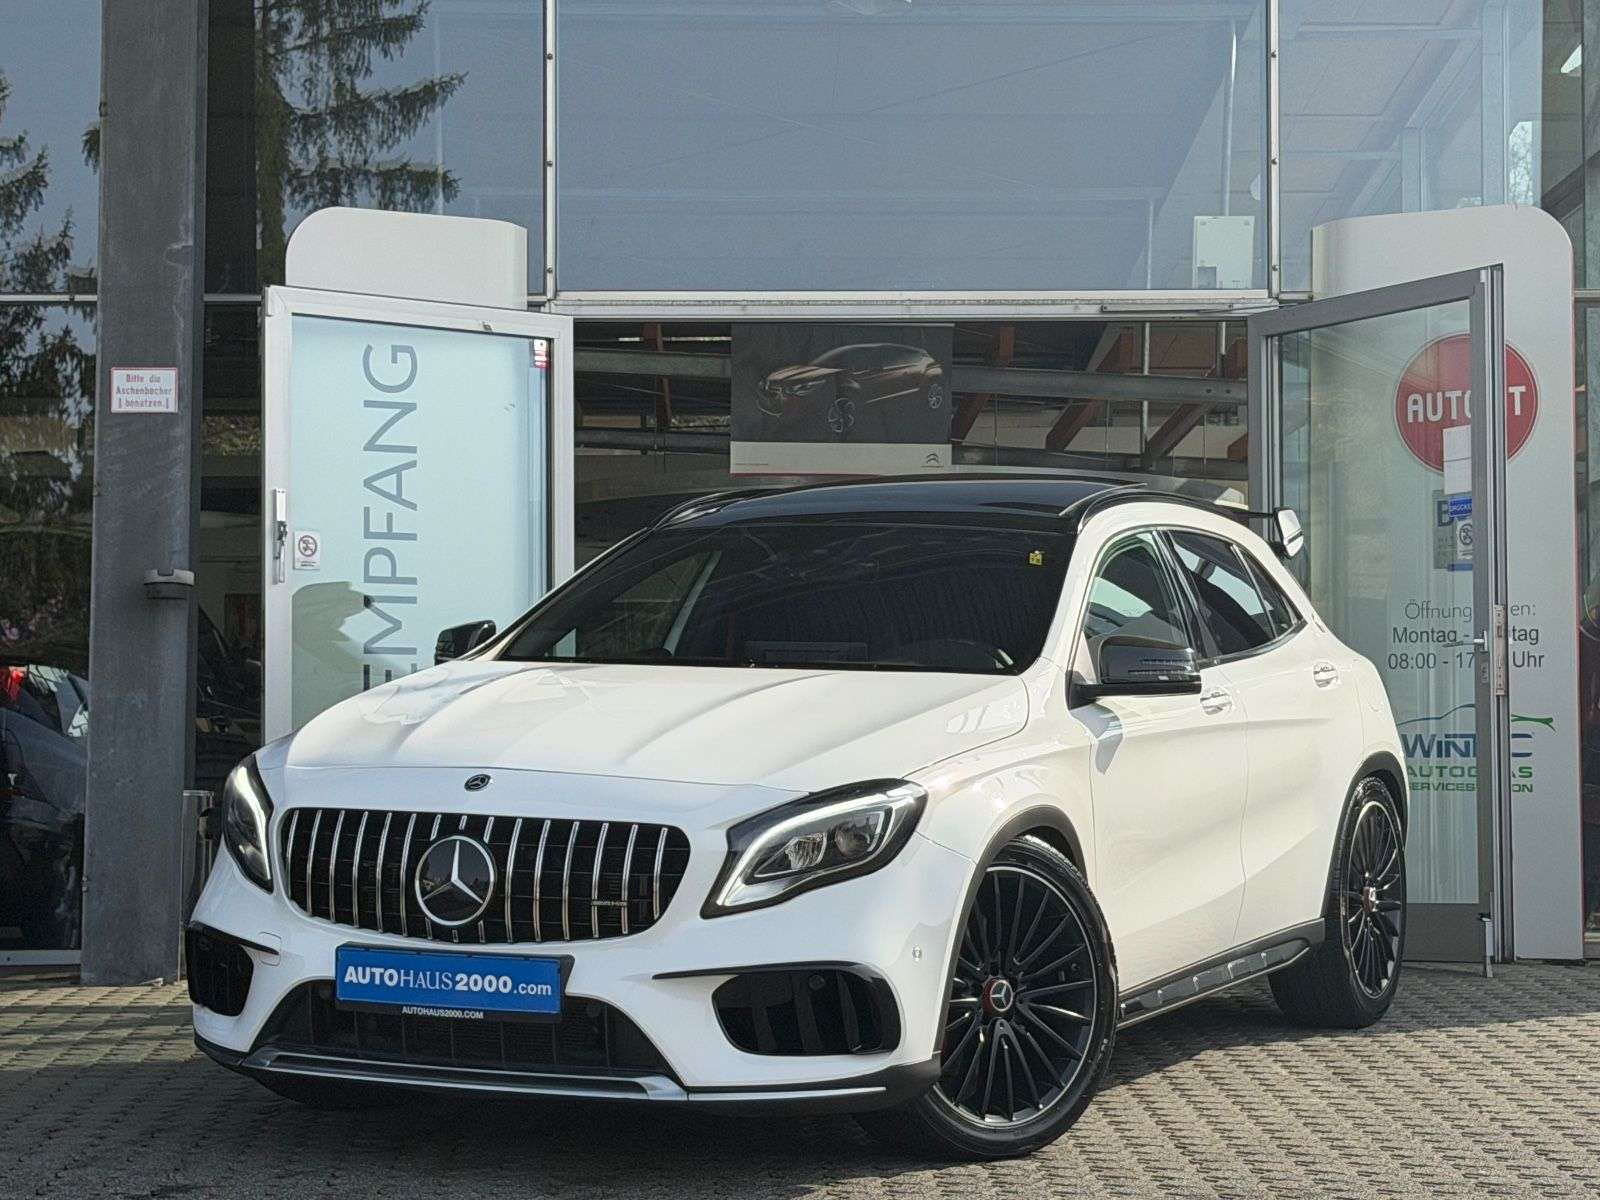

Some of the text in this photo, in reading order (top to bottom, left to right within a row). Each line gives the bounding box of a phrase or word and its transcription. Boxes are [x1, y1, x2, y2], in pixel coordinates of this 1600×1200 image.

[1388, 652, 1437, 669] 08:00
[1512, 650, 1545, 668] Uhr
[402, 1006, 484, 1019] AUTOHAUS2000.COM
